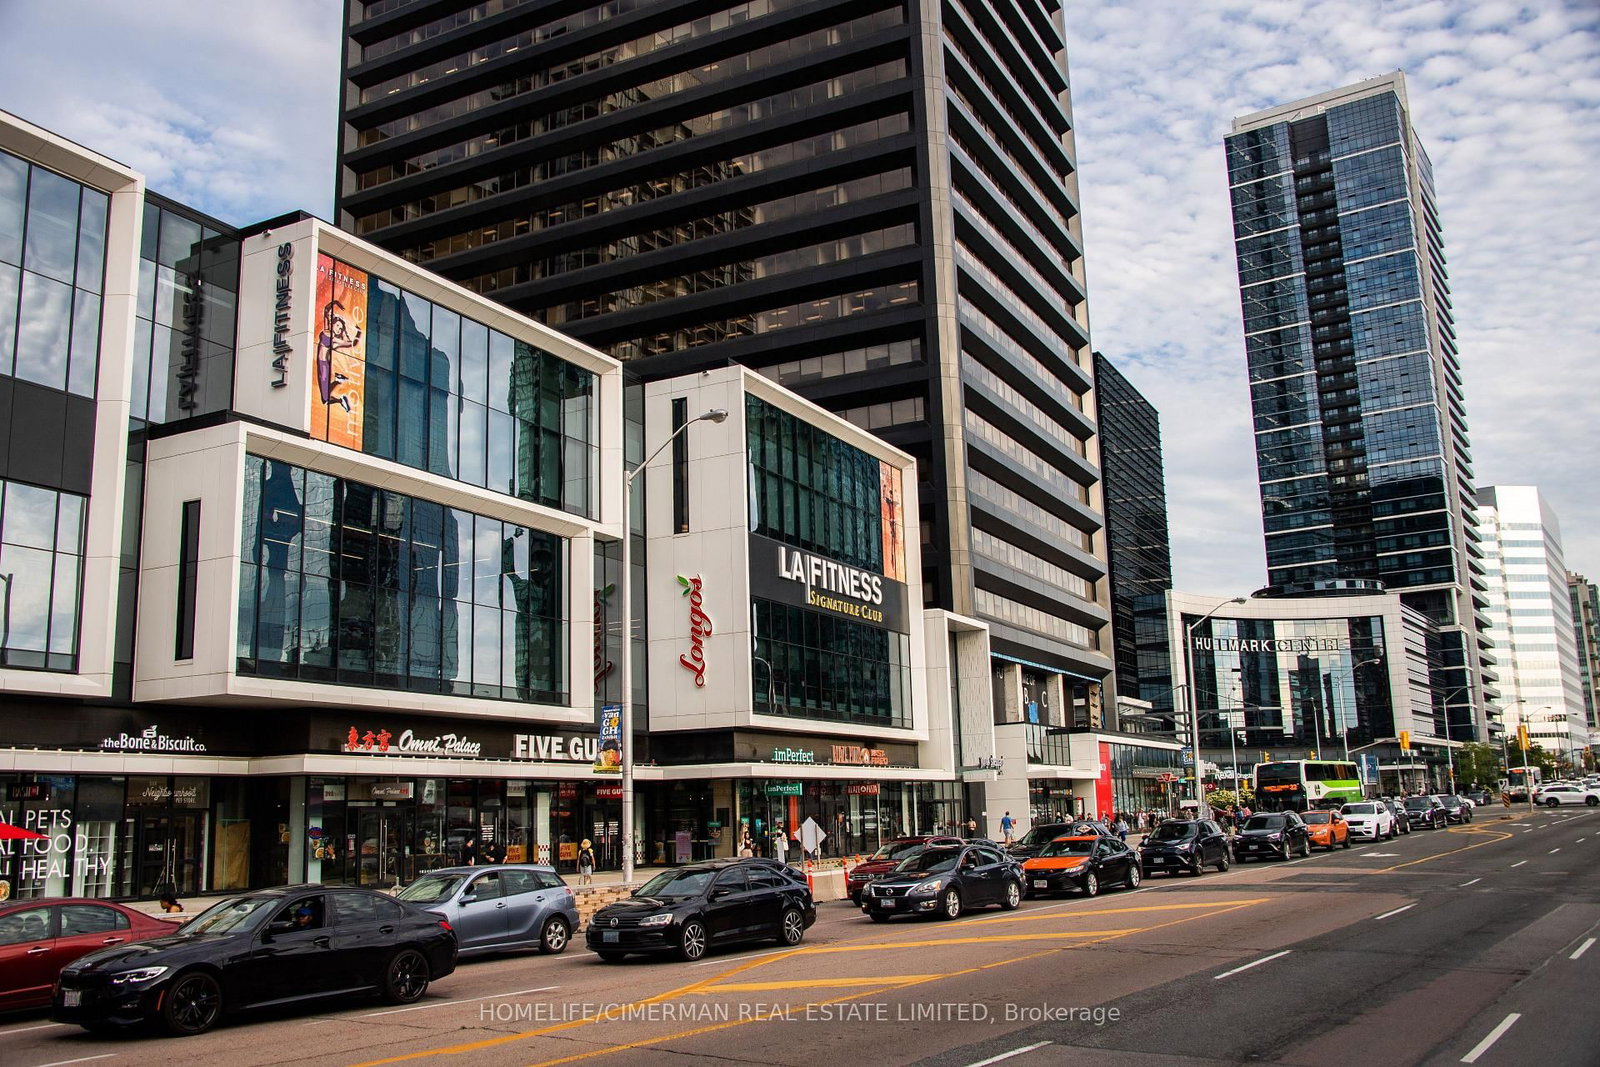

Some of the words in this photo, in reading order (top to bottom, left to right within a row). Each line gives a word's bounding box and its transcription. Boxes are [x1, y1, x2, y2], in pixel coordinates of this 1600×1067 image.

[329, 269, 366, 290] FITNESS
[273, 241, 295, 348] FITNESS
[778, 546, 805, 584] LA
[810, 555, 883, 605] FITNESS
[399, 729, 441, 751] Omni
[442, 732, 481, 755] Palace
[514, 734, 564, 759] FIVE
[774, 747, 814, 763] imPerfect
[25, 809, 81, 830] PETS.
